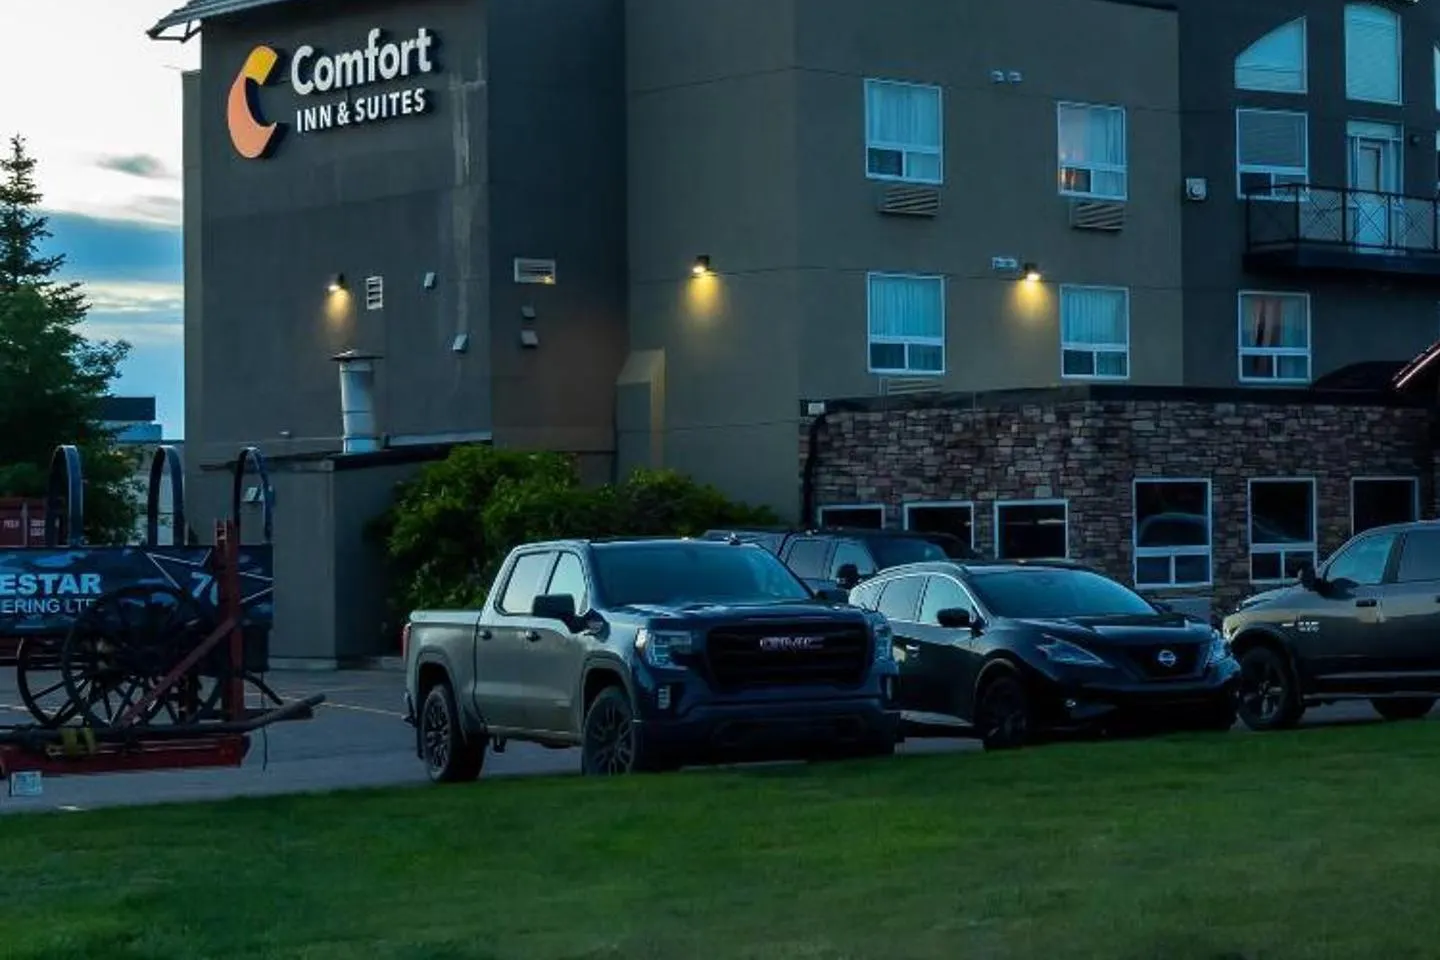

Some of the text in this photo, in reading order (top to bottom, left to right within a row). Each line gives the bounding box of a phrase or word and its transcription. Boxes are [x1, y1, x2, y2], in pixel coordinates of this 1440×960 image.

[291, 28, 432, 95] Comfort
[297, 88, 426, 133] INN & SUITES
